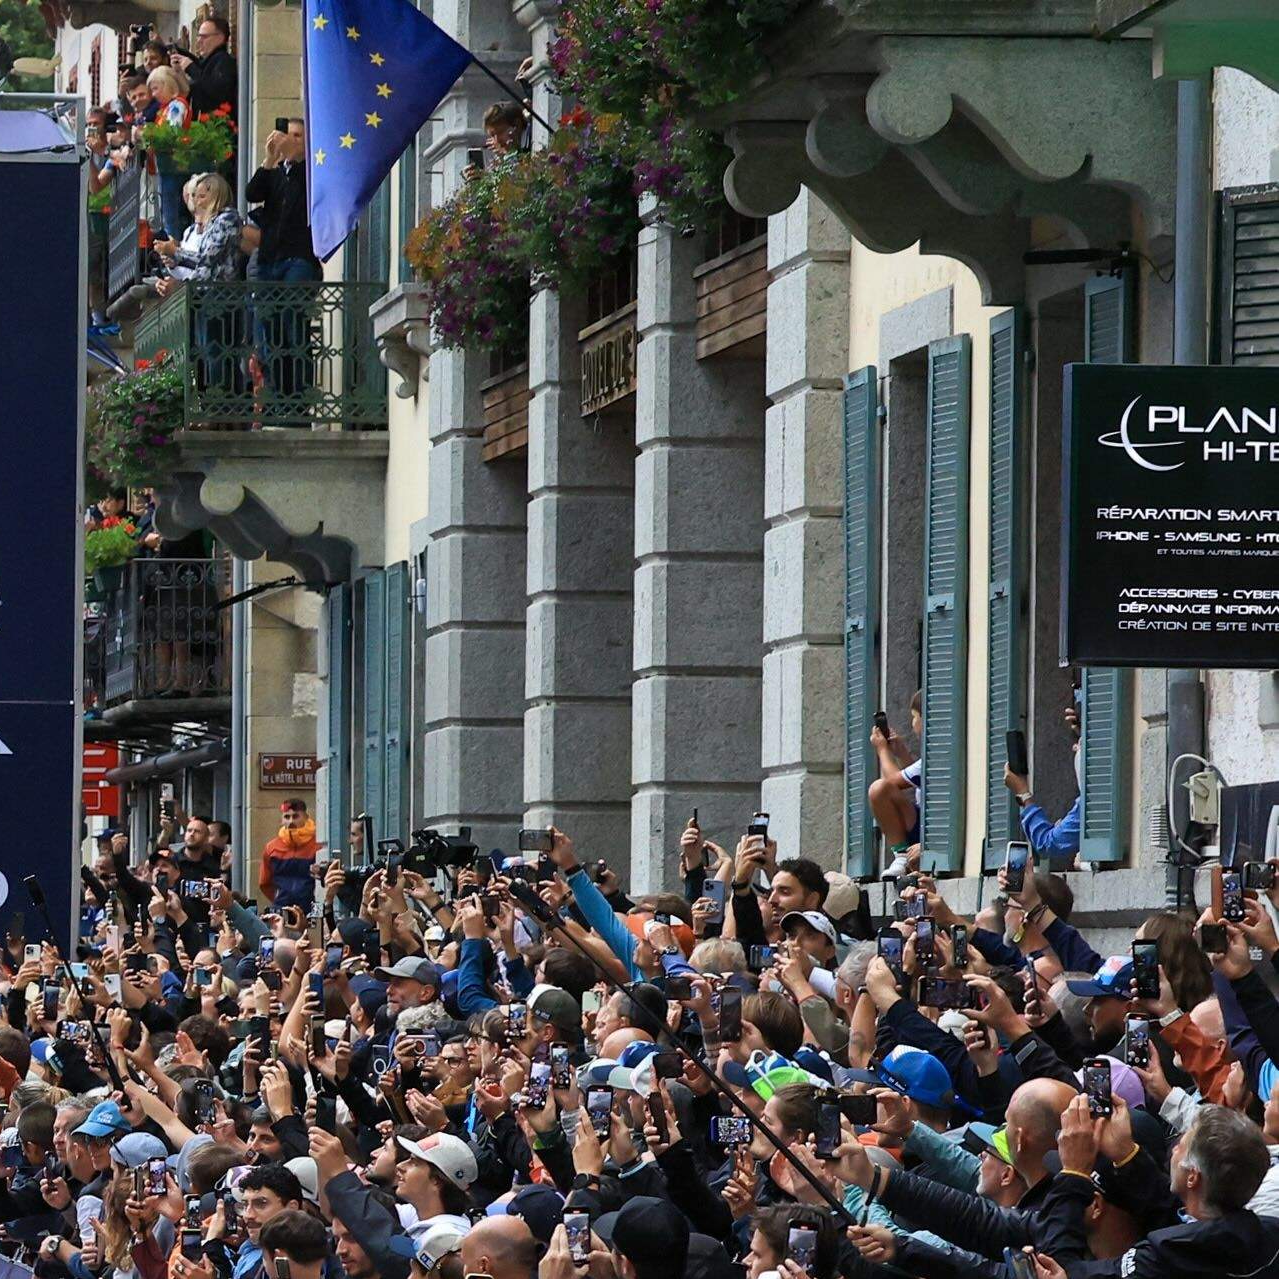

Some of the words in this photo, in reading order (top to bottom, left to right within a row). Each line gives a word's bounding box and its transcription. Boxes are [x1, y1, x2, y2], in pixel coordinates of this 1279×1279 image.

[1148, 405, 1277, 434] PLAN
[1096, 504, 1212, 521] RÉPARATION
[1096, 531, 1150, 542] IPHONE
[1164, 531, 1242, 543] SAMSUNG
[1119, 587, 1219, 599] ACCESSOIRES
[1118, 601, 1211, 615] DÉPANNAGE
[1118, 618, 1188, 632] CRÉATION
[1192, 621, 1212, 632] DE
[1216, 621, 1248, 633] SITE
[286, 758, 312, 770] RUE
